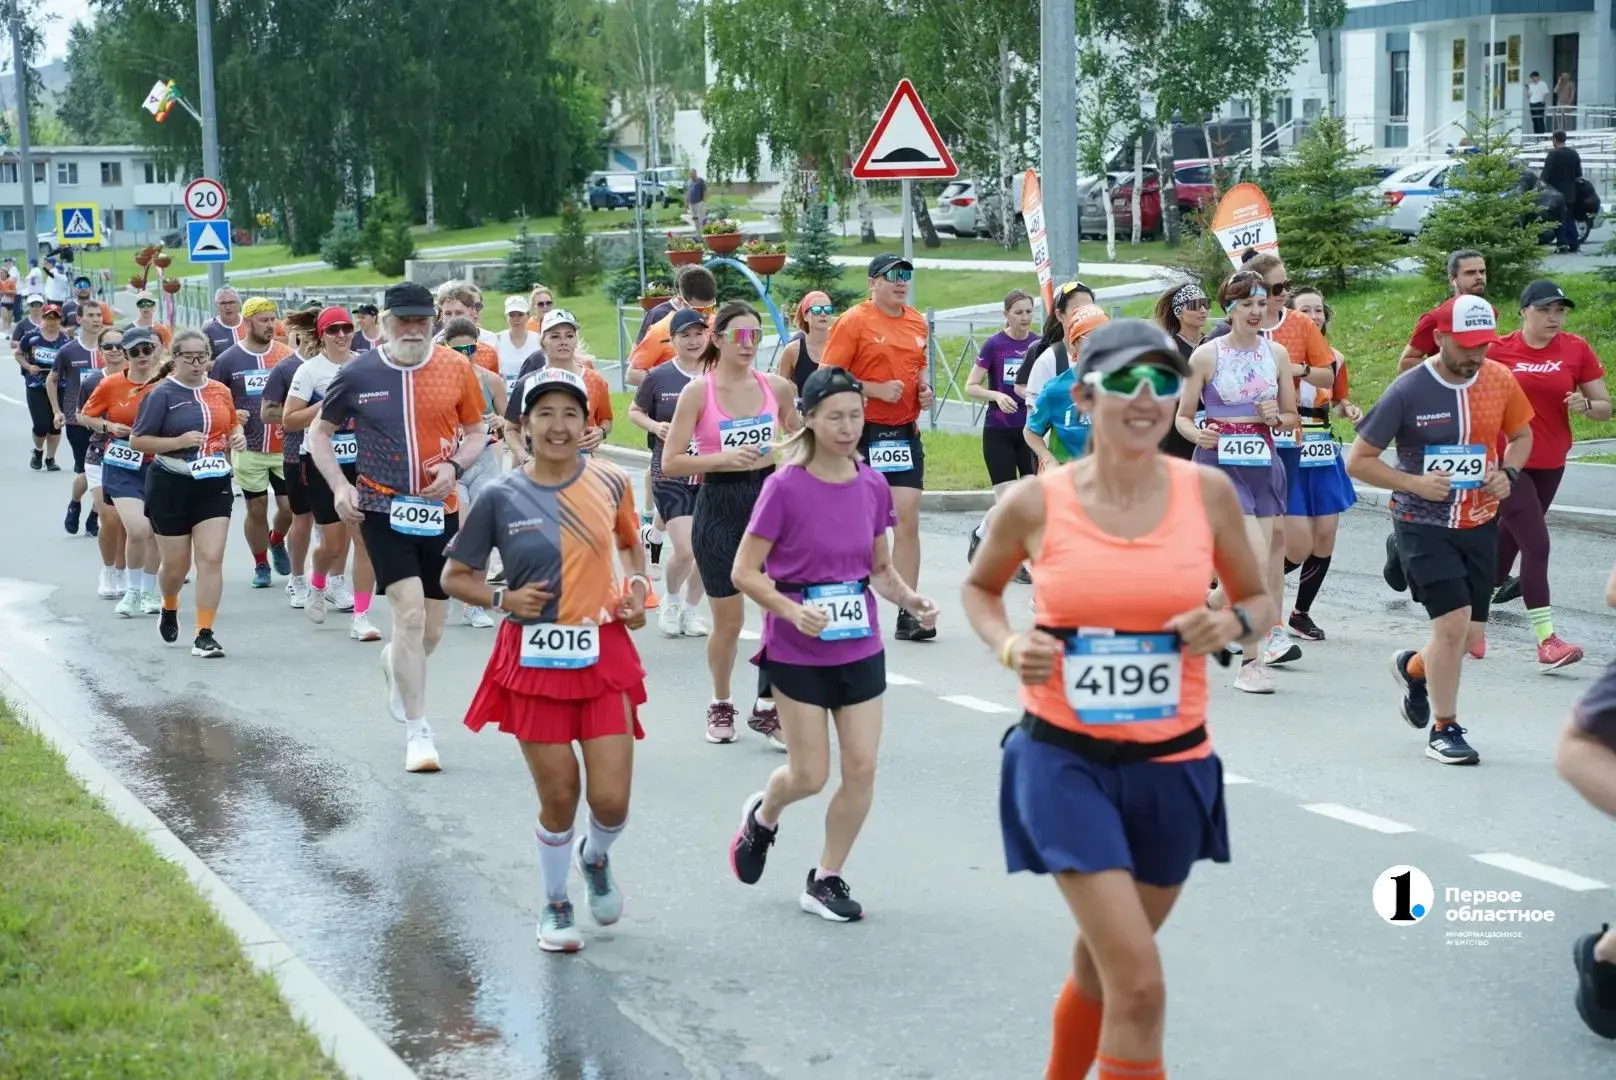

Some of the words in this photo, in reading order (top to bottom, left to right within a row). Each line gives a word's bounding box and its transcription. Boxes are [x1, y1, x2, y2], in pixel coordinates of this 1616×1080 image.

[194, 190, 217, 208] 20
[1465, 318, 1493, 327] ULTRA
[724, 427, 771, 448] 4298
[108, 448, 141, 462] 4392
[871, 450, 910, 463] 4065
[1223, 441, 1265, 455] 4167
[1300, 444, 1332, 457] 4028
[191, 459, 225, 471] 4447
[1426, 458, 1482, 475] 4249
[392, 507, 443, 525] 4094
[817, 600, 863, 622] 148
[529, 629, 592, 650] 4016
[1075, 664, 1170, 696] 4196
